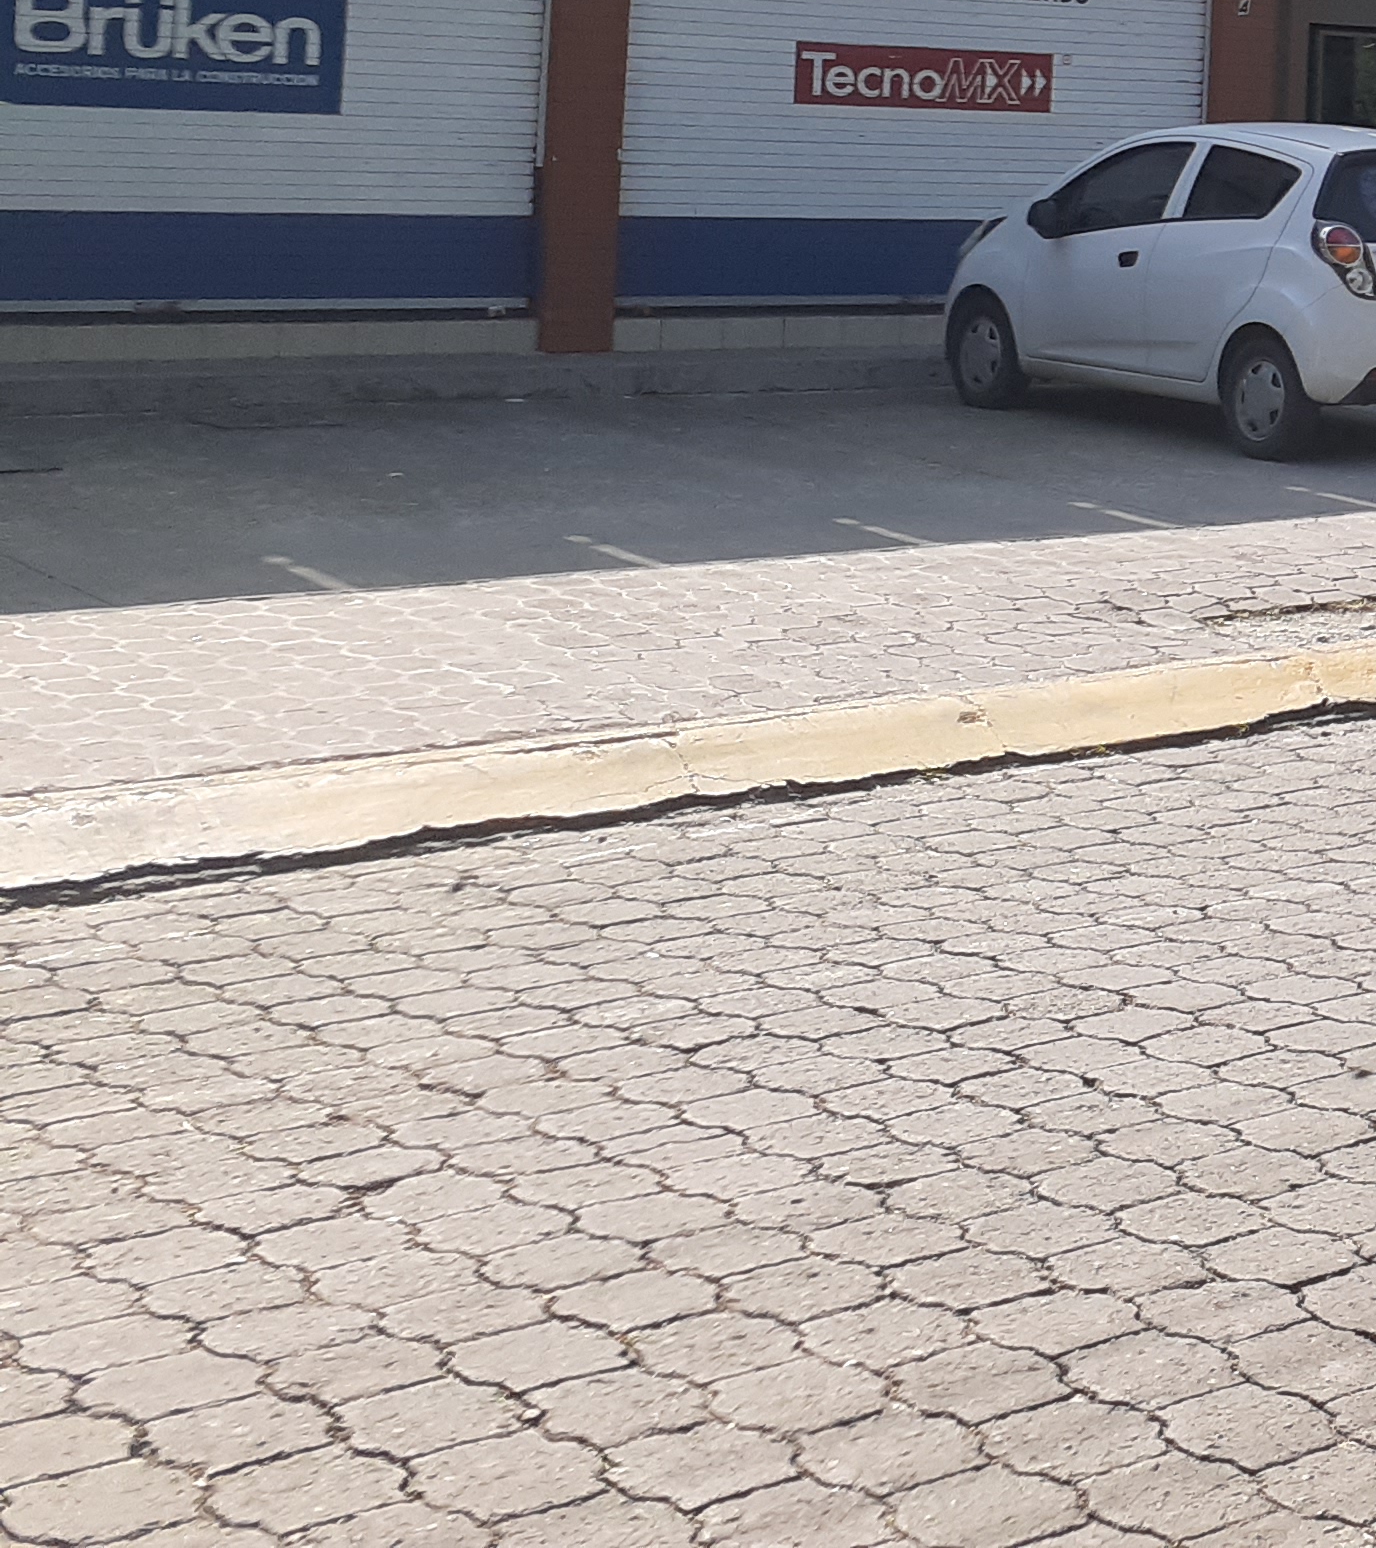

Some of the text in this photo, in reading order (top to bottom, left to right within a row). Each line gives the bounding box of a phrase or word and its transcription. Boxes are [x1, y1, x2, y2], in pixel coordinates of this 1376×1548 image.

[1239, 0, 1250, 14] 4
[124, 67, 170, 82] PARA
[172, 68, 192, 82] LA
[800, 50, 1021, 105] TecnoMX
